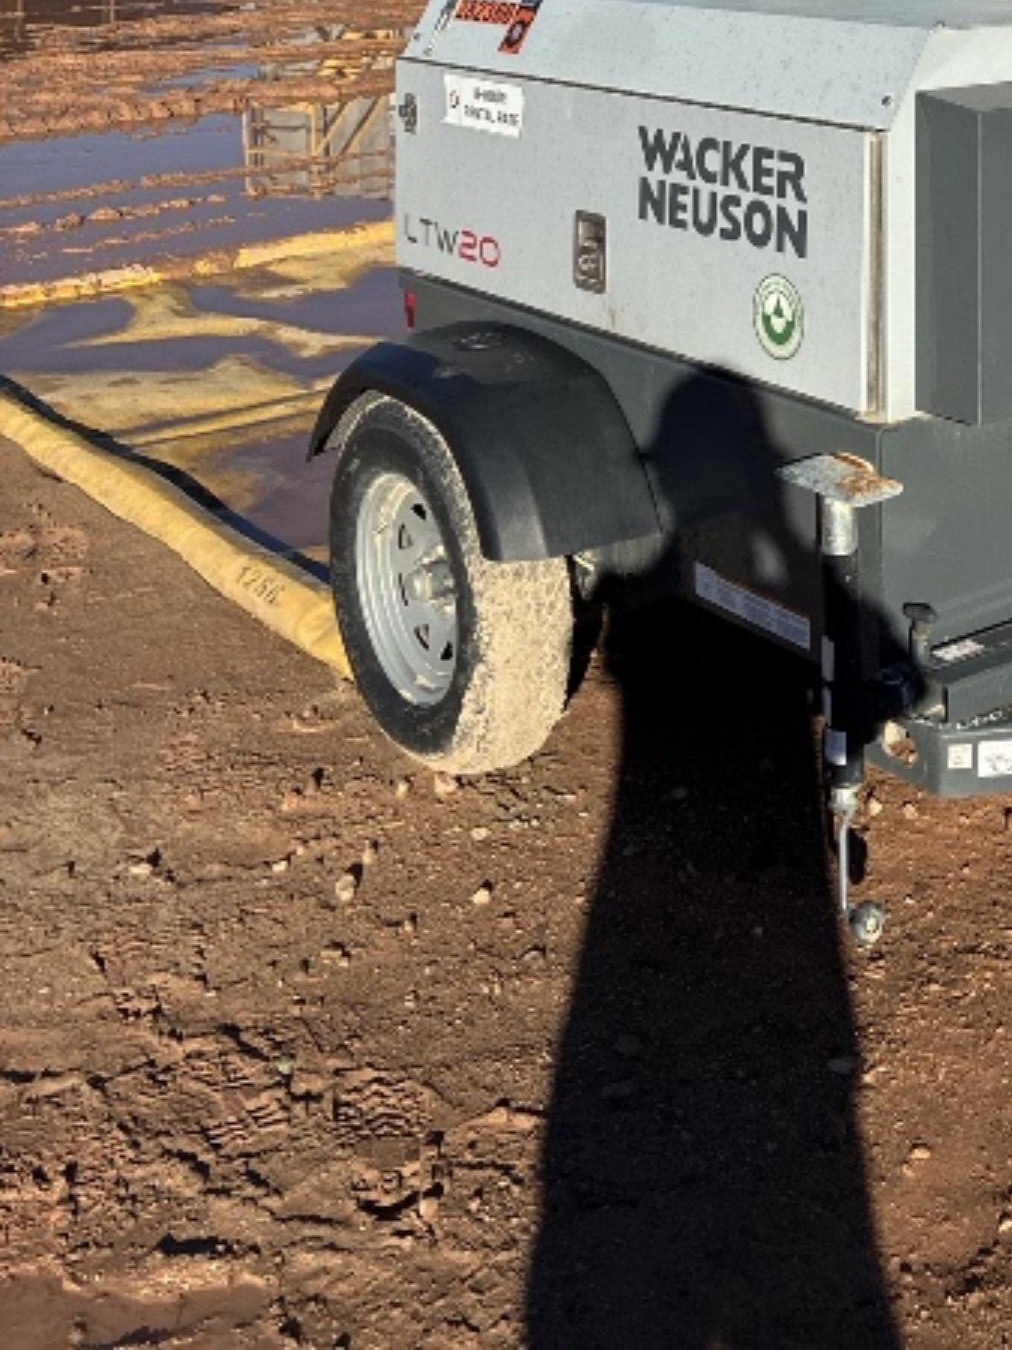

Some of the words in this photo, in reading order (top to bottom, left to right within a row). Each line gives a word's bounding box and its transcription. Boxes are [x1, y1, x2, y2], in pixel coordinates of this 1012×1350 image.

[638, 125, 808, 205] WACKER
[403, 212, 501, 267] LTW20
[638, 176, 808, 259] NEUSON
